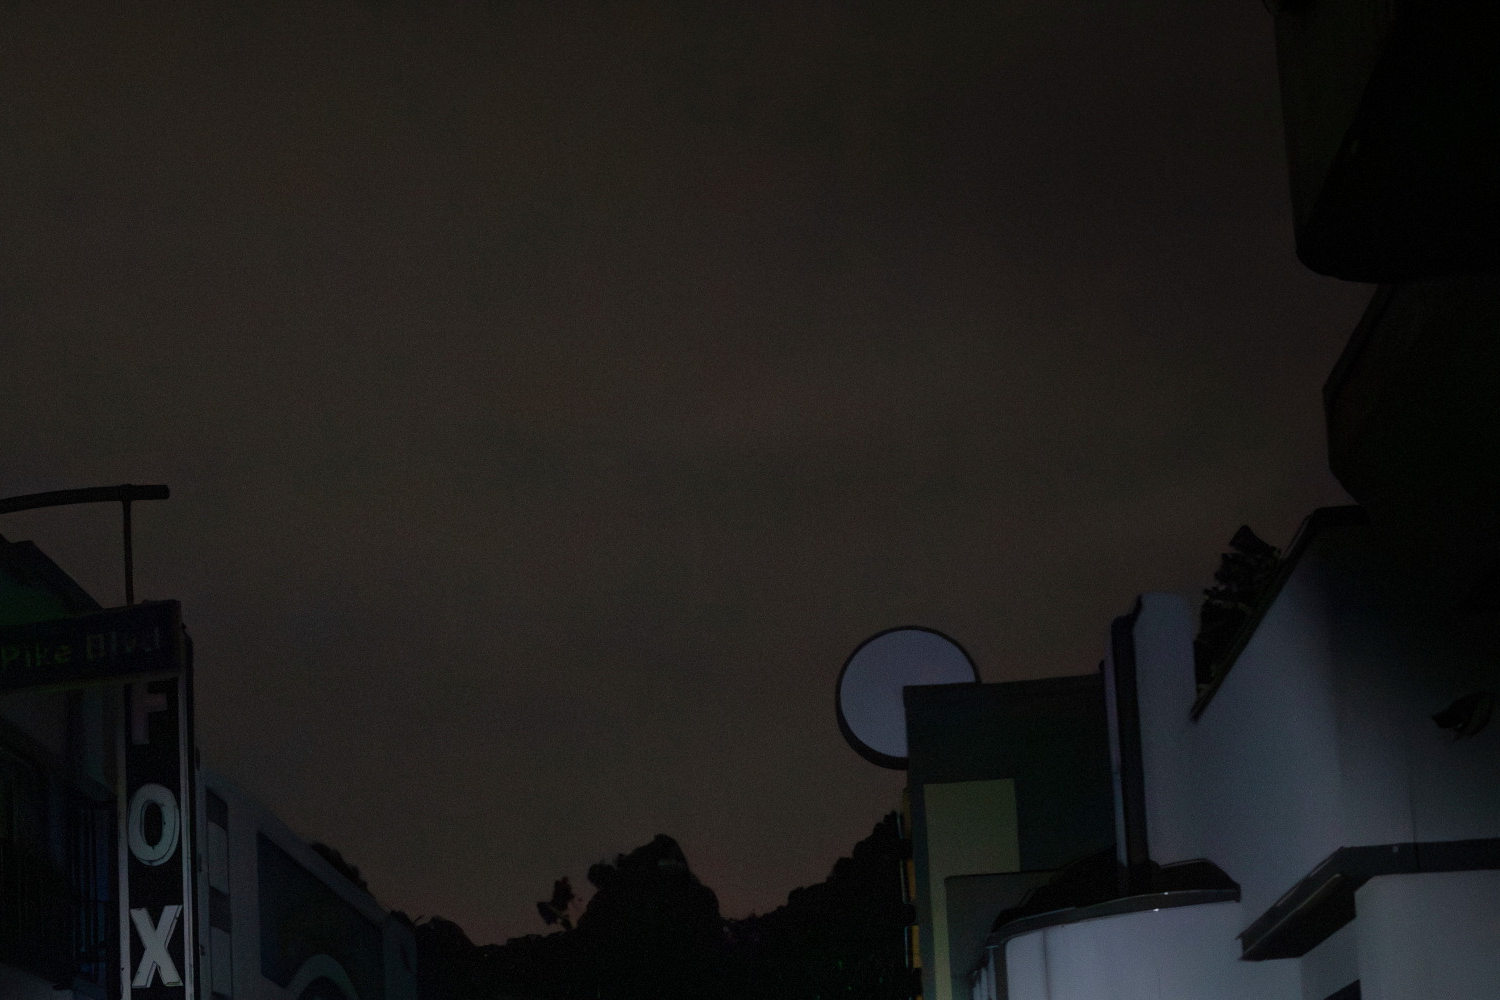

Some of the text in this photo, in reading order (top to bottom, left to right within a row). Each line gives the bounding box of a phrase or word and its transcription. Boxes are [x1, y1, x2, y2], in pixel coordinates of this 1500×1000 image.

[1, 640, 71, 672] Pike
[85, 625, 162, 661] Blvd
[128, 682, 183, 989] FOX
